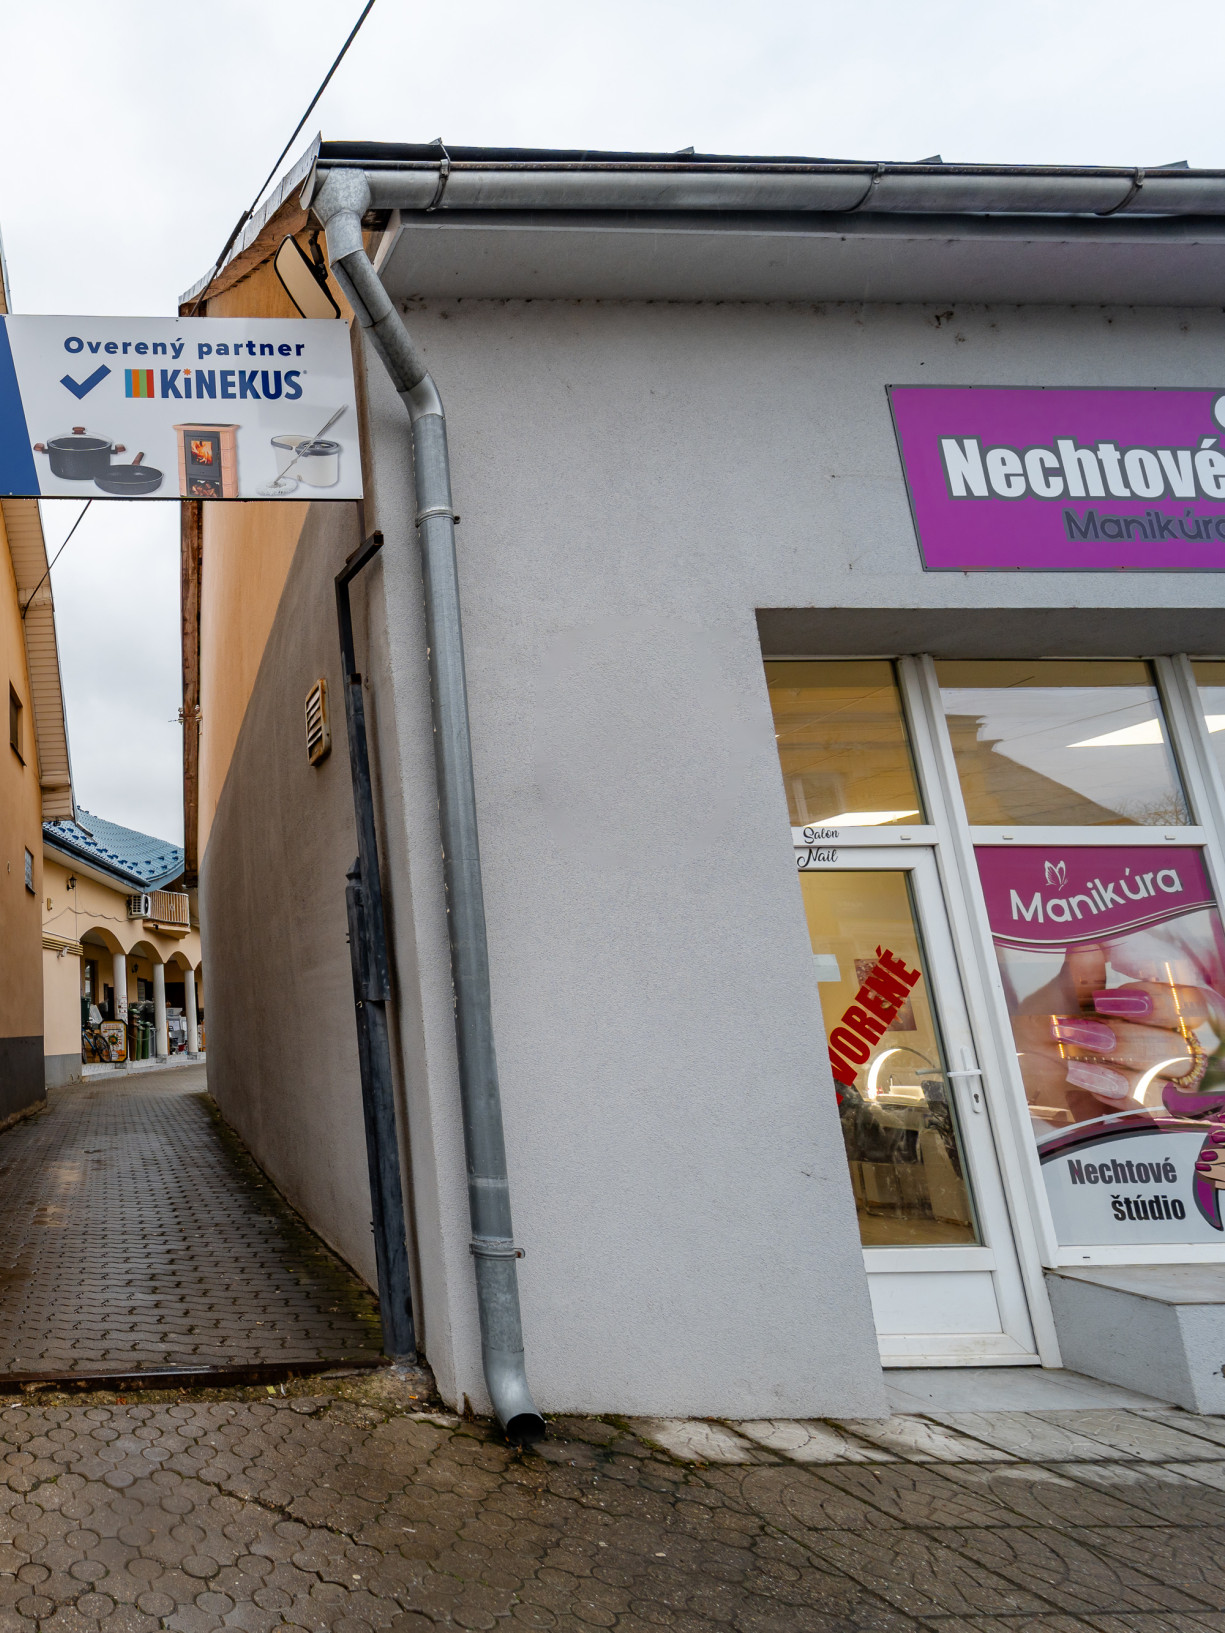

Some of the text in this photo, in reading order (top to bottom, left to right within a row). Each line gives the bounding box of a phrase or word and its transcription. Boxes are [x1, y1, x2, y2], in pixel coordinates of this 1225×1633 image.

[63, 336, 305, 359] Overený partner
[940, 438, 1225, 499] Nechtové
[803, 826, 840, 844] Salon
[797, 847, 838, 868] Nail
[1009, 867, 1183, 923] Manikúra
[828, 944, 922, 1105] VORENÉ
[1067, 1156, 1178, 1185] Nechtové
[1111, 1194, 1186, 1222] štúdio
